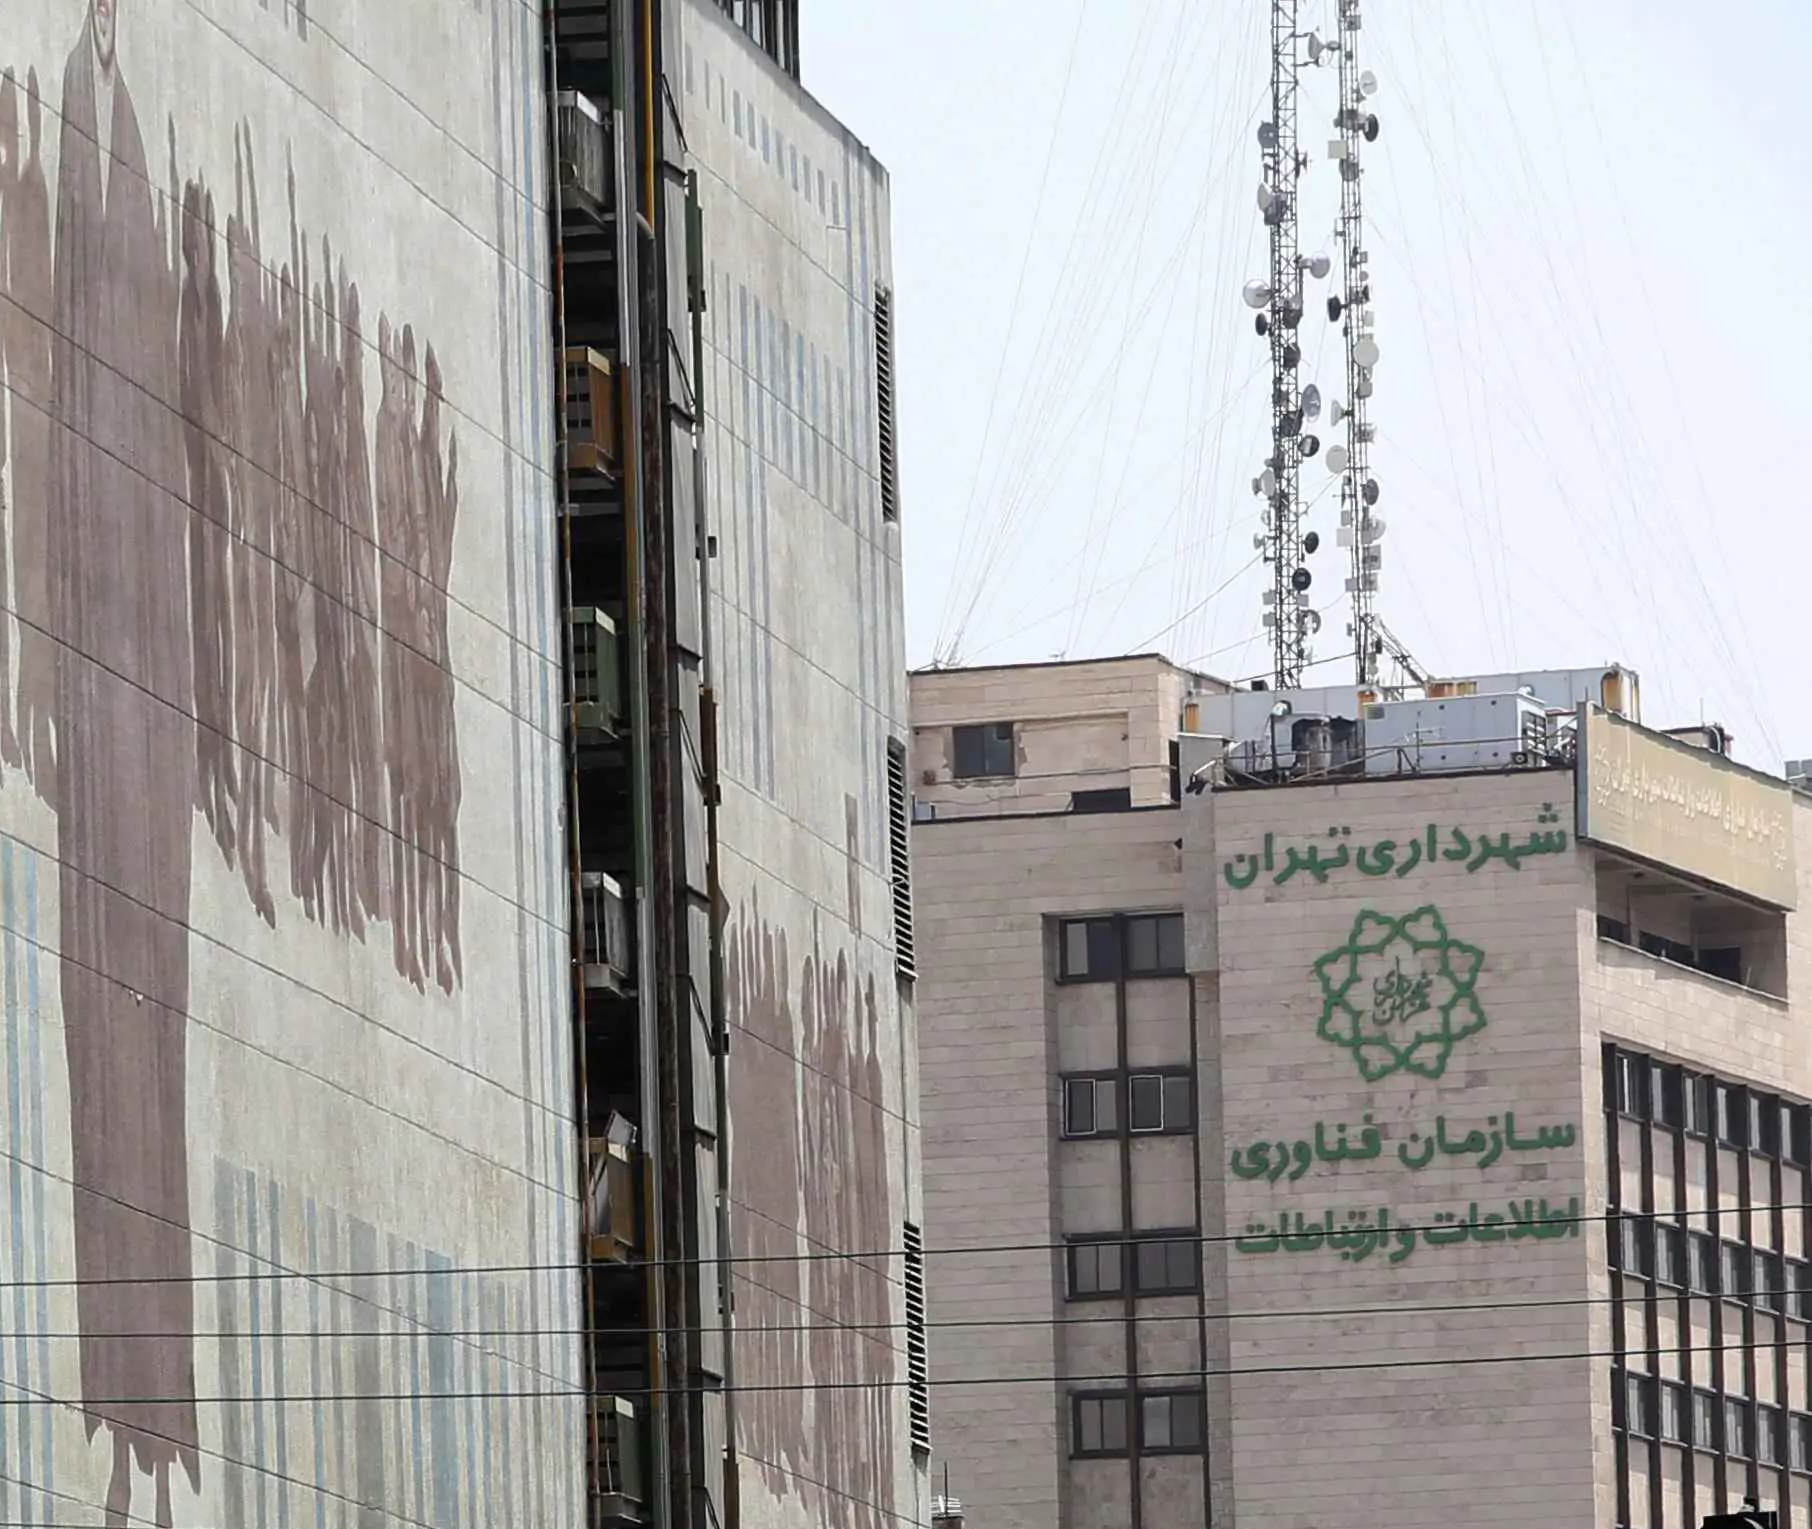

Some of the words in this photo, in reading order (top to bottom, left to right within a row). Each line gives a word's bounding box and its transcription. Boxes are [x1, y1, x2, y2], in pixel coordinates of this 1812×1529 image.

[1224, 826, 1350, 889] تهران
[1356, 802, 1567, 878] شهرداری
[1230, 1113, 1382, 1182] فناوری
[1398, 1112, 1575, 1168] سازمان
[1234, 1208, 1388, 1261] ارتباطات
[1423, 1197, 1580, 1245] اطلاعات
